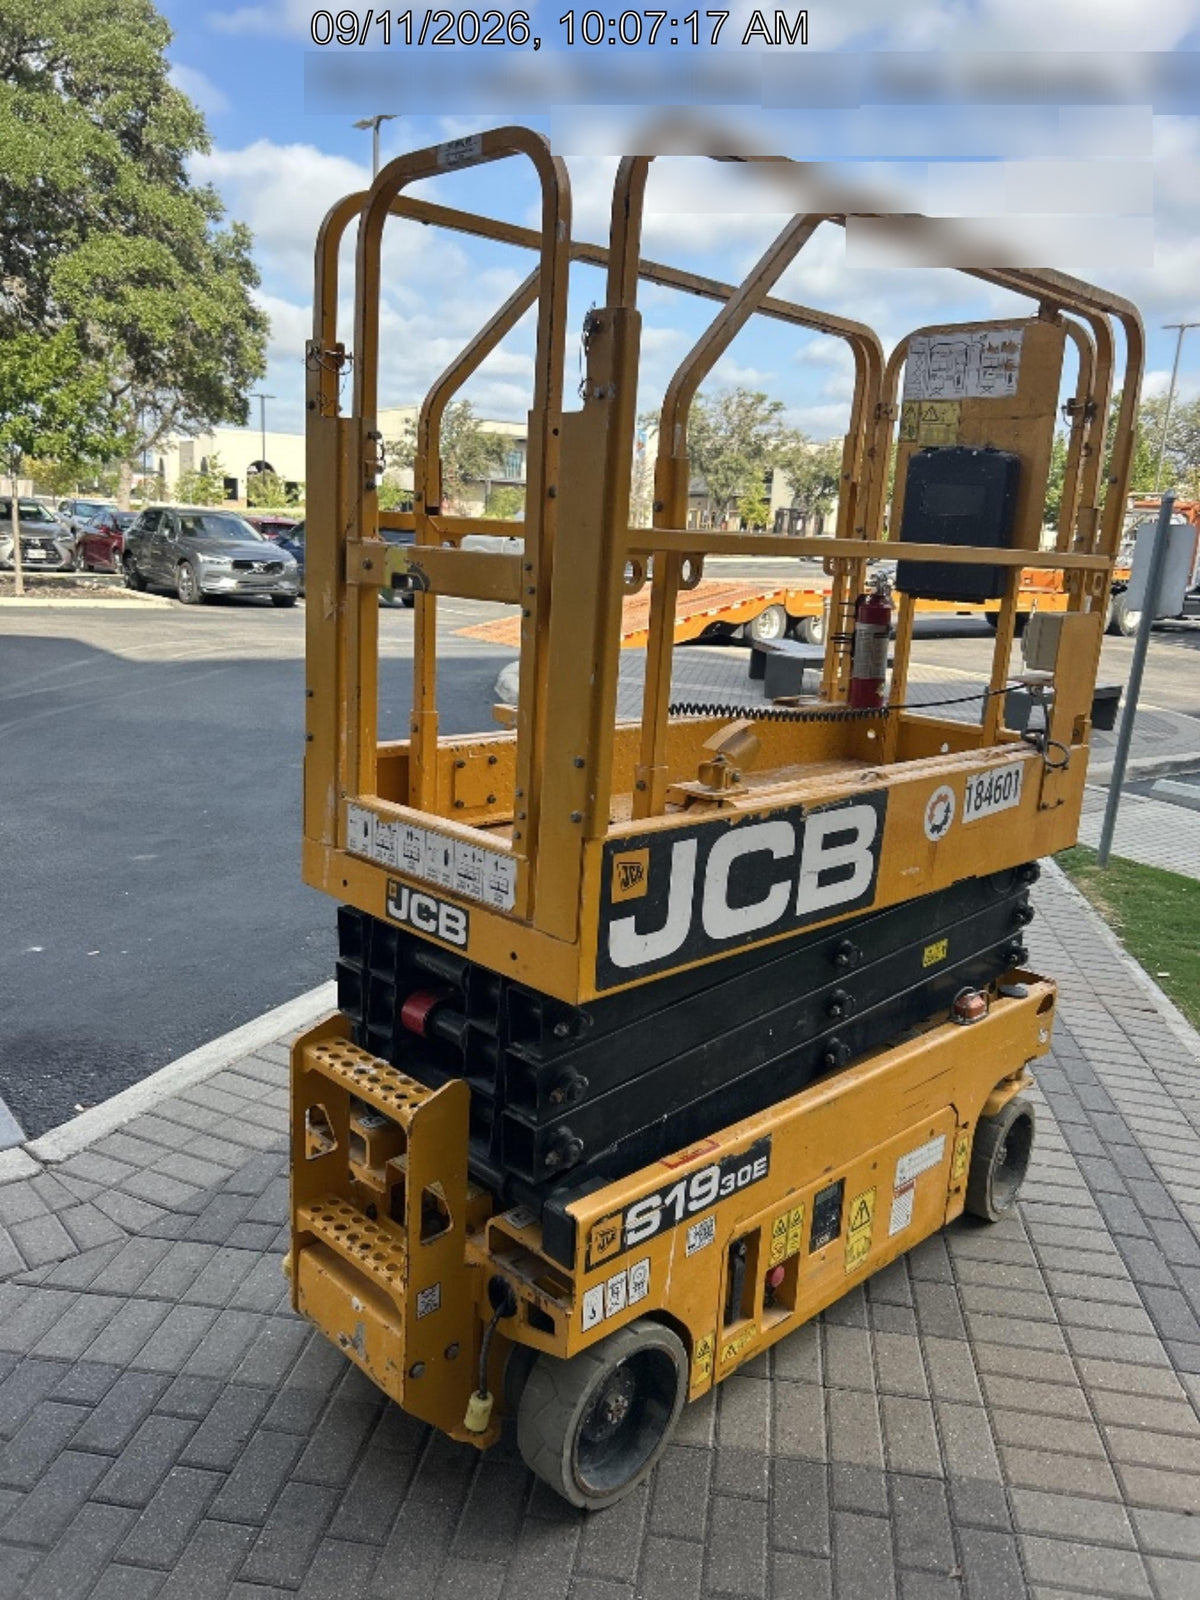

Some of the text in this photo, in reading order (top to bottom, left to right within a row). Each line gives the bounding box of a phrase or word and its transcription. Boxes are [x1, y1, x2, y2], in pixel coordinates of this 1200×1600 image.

[965, 769, 1020, 814] 184601
[387, 886, 467, 946] JCB
[608, 804, 878, 969] JCB
